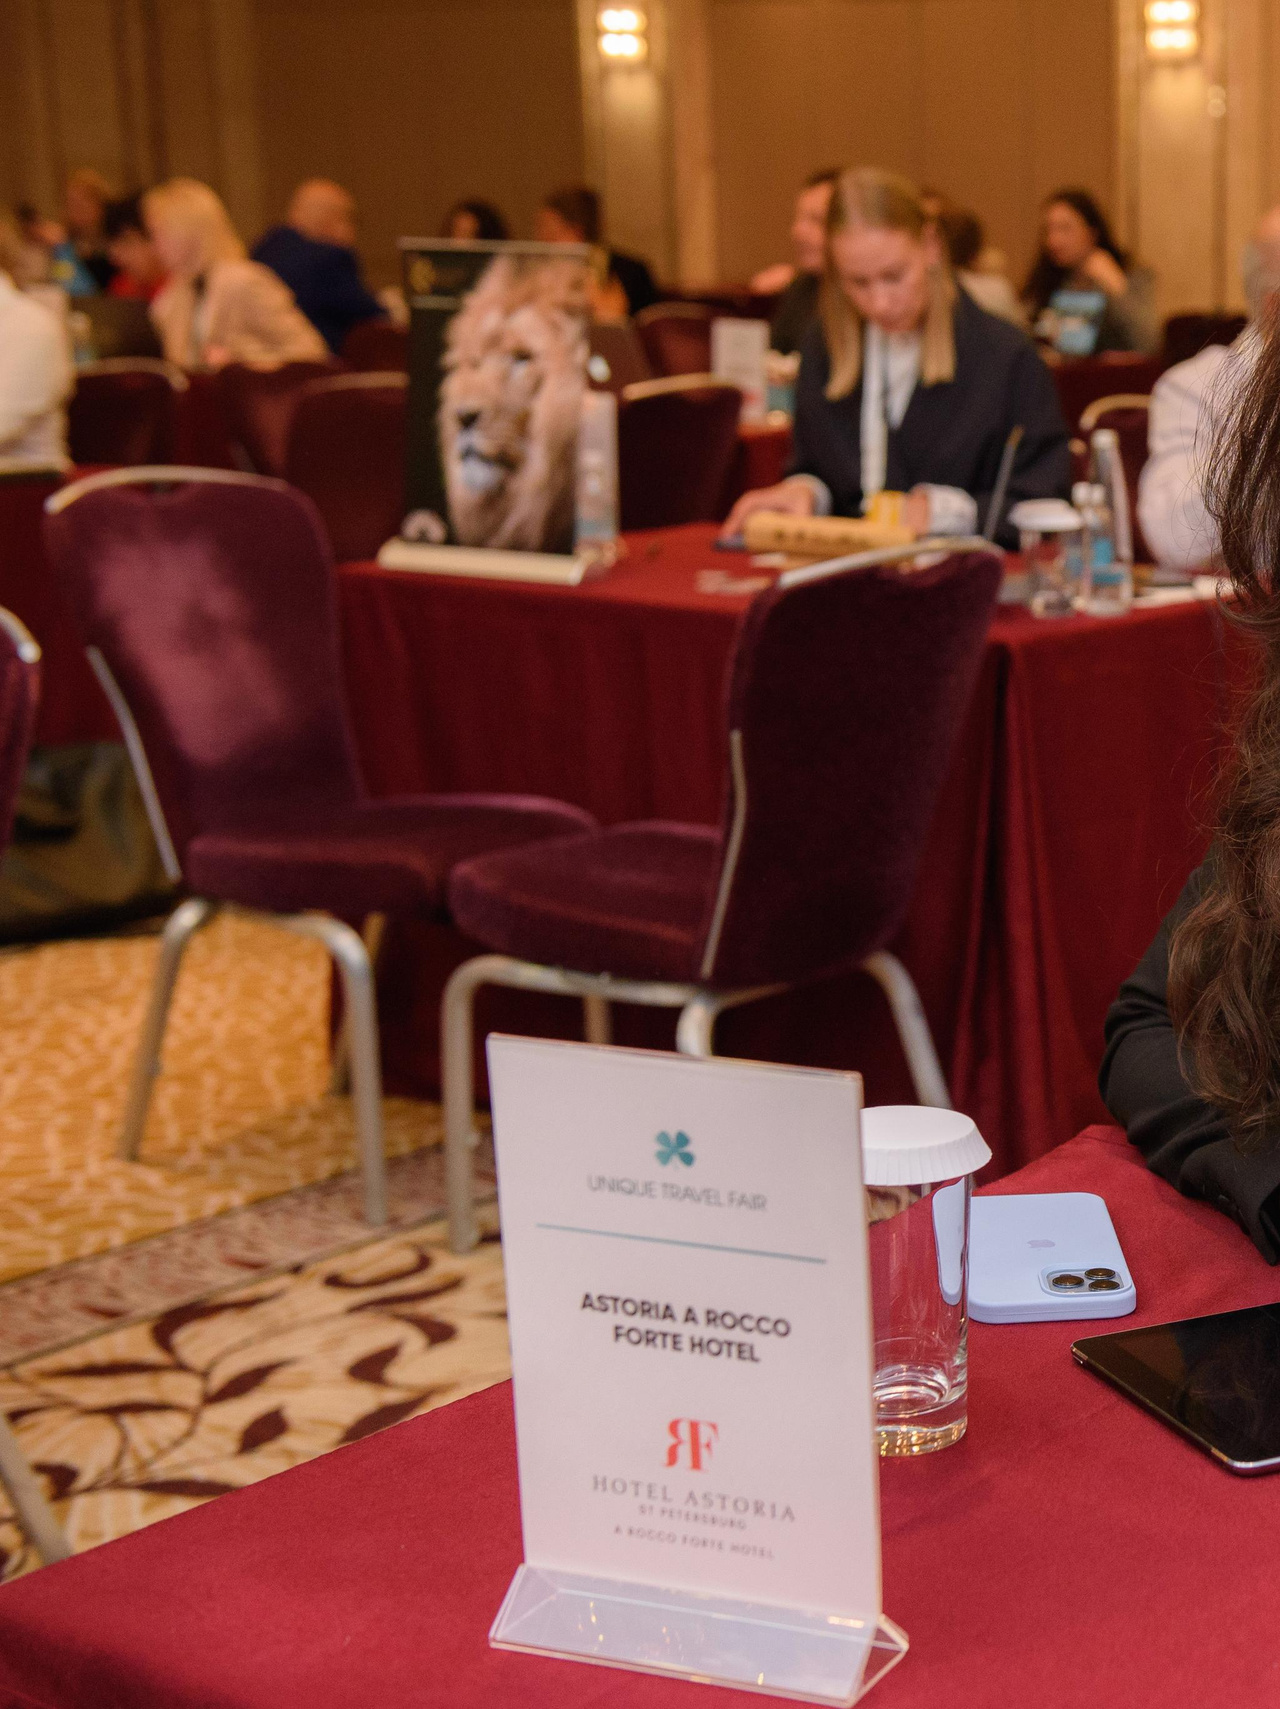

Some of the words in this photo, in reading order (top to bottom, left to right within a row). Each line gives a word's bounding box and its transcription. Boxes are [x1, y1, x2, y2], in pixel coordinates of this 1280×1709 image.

[588, 1175, 656, 1199] UNIQUE
[661, 1183, 722, 1207] TRAVEL
[729, 1191, 767, 1211] FAIR
[581, 1292, 676, 1322] ASTORIA
[684, 1306, 698, 1325] A
[705, 1309, 791, 1338] ROCCO
[614, 1325, 683, 1352] FORTE
[690, 1336, 760, 1363] HOTEL
[592, 1475, 674, 1502] HOTEL
[684, 1490, 796, 1523] ASTORIA
[638, 1504, 654, 1515] ST
[660, 1507, 747, 1530] PETERSBURG
[614, 1525, 623, 1535] A
[627, 1526, 677, 1544] ROCCO
[681, 1535, 724, 1551] FORTE
[729, 1542, 775, 1559] HOTEL
